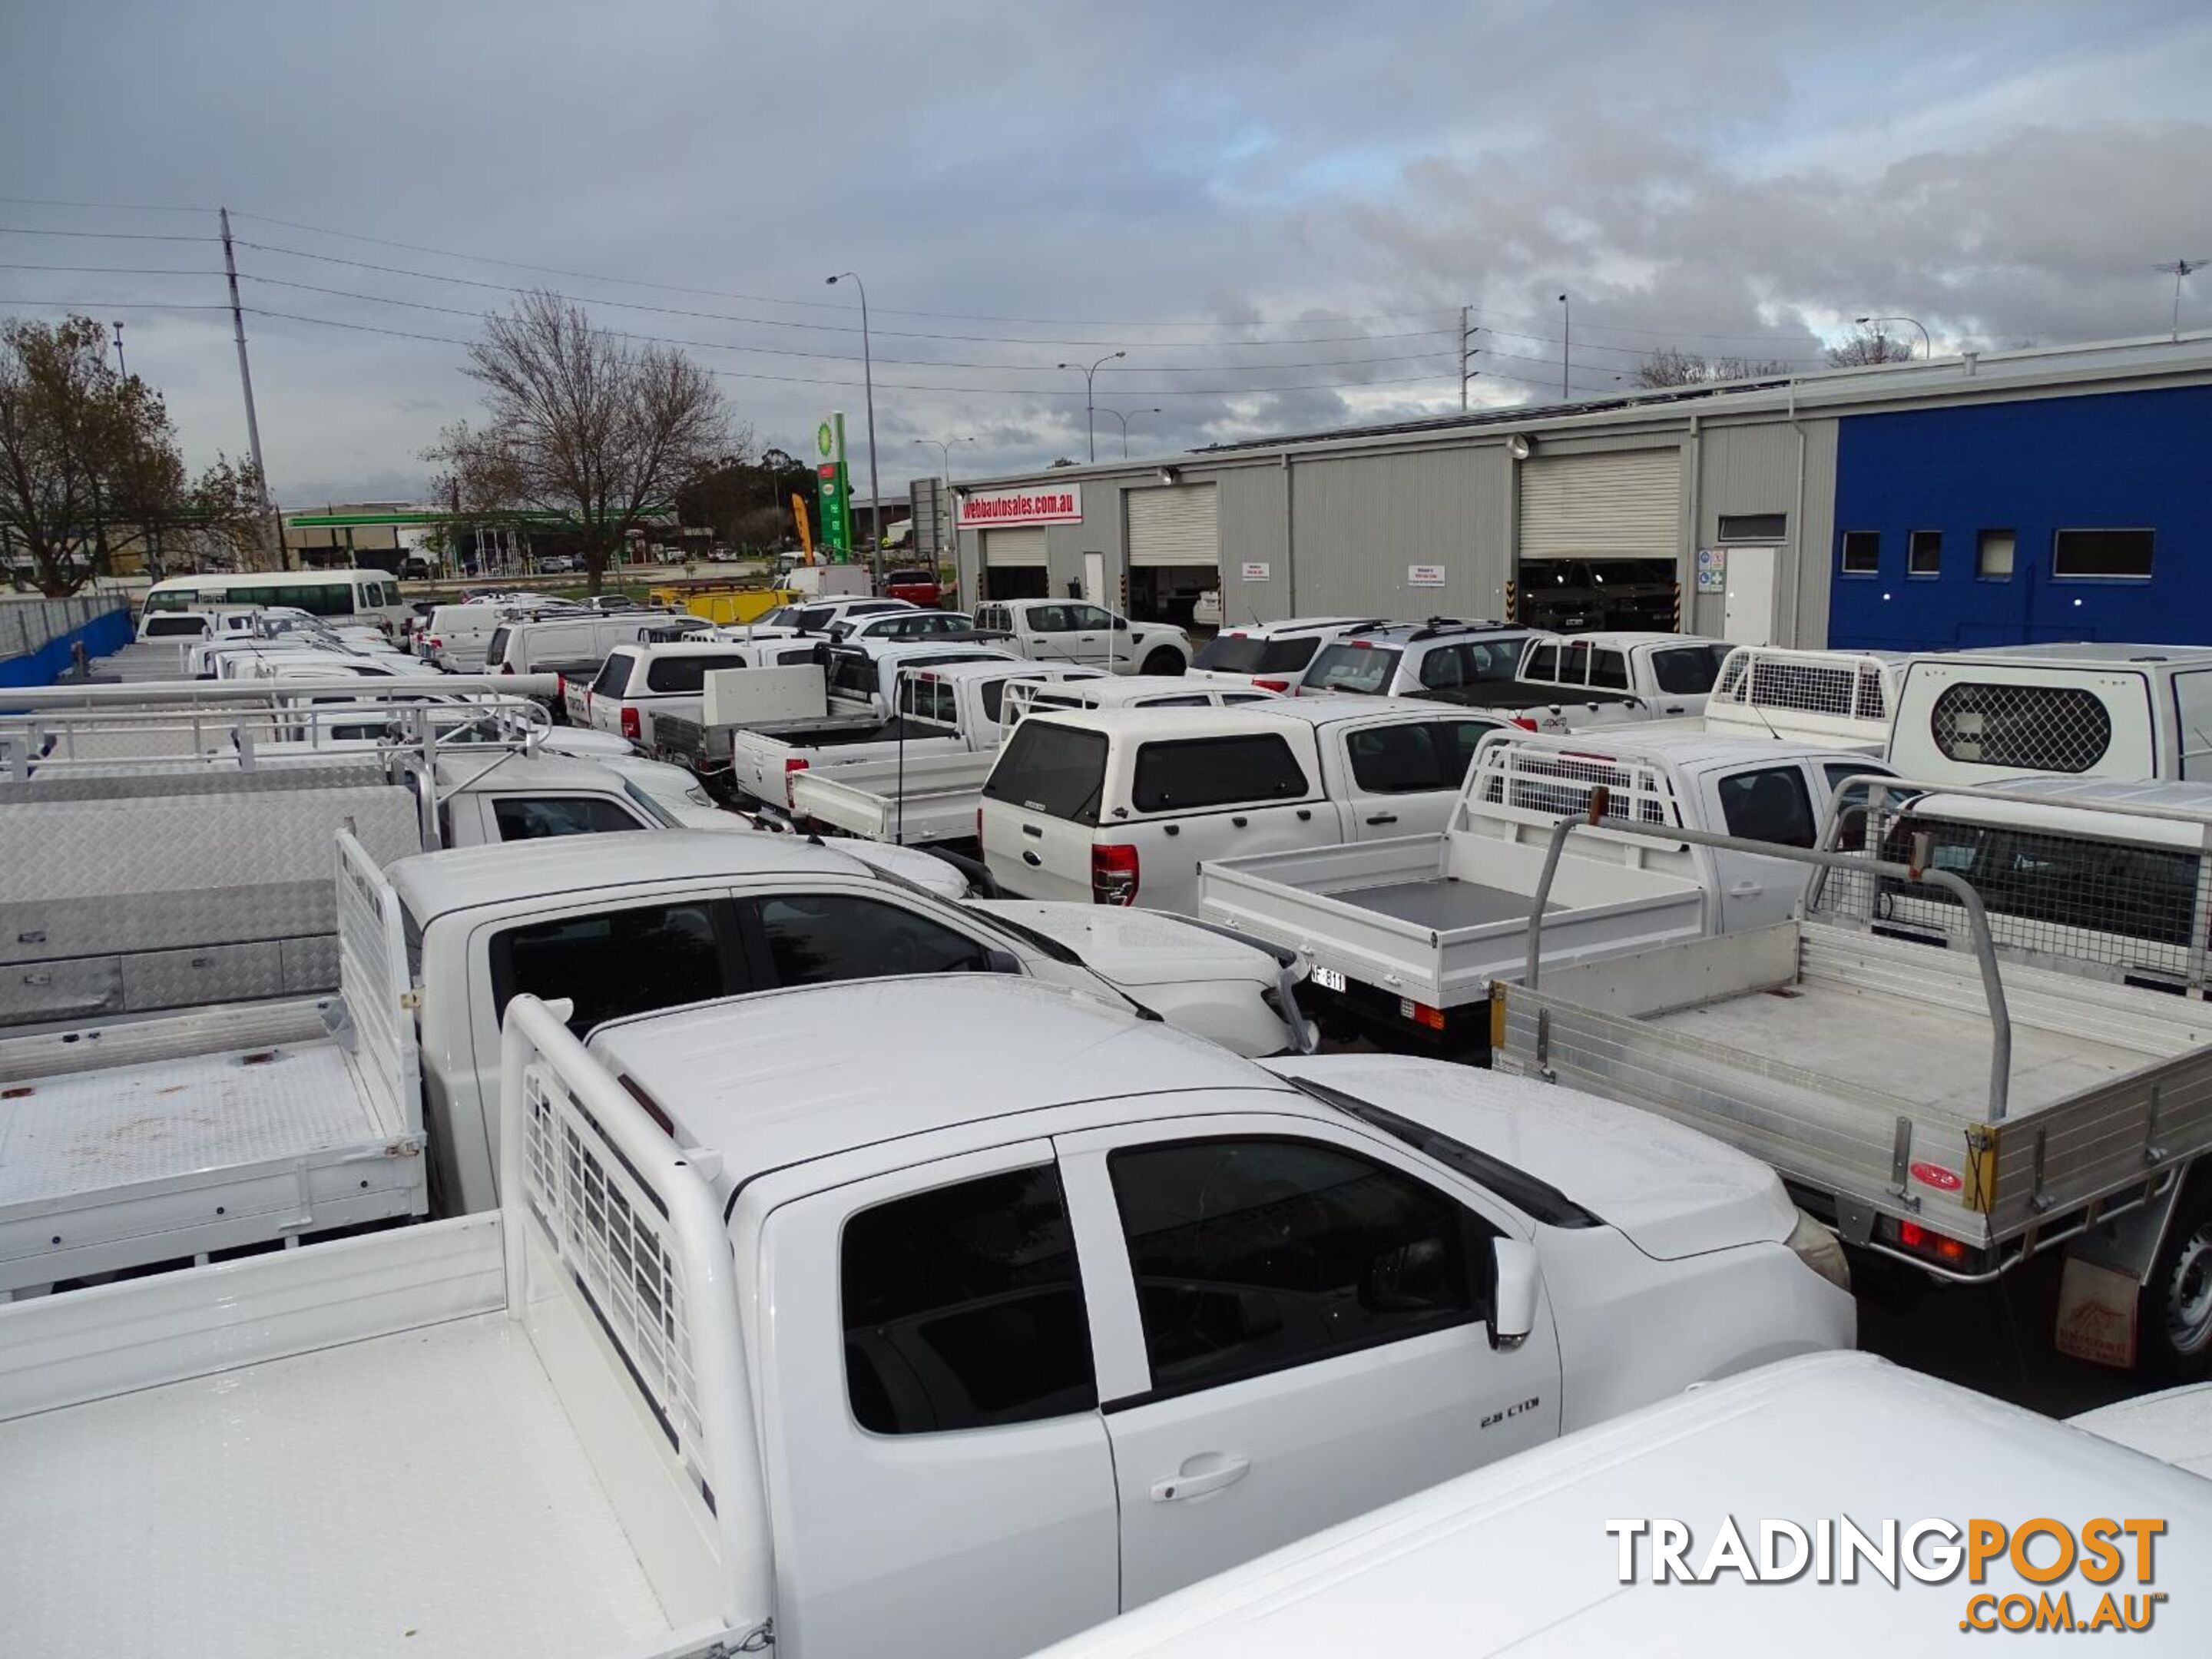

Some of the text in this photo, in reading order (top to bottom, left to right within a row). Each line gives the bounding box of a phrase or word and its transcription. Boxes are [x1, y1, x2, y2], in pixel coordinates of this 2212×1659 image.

[963, 494, 1073, 518] webbautosales.com.au
[1480, 1396, 1540, 1428] 2.8 CTDI
